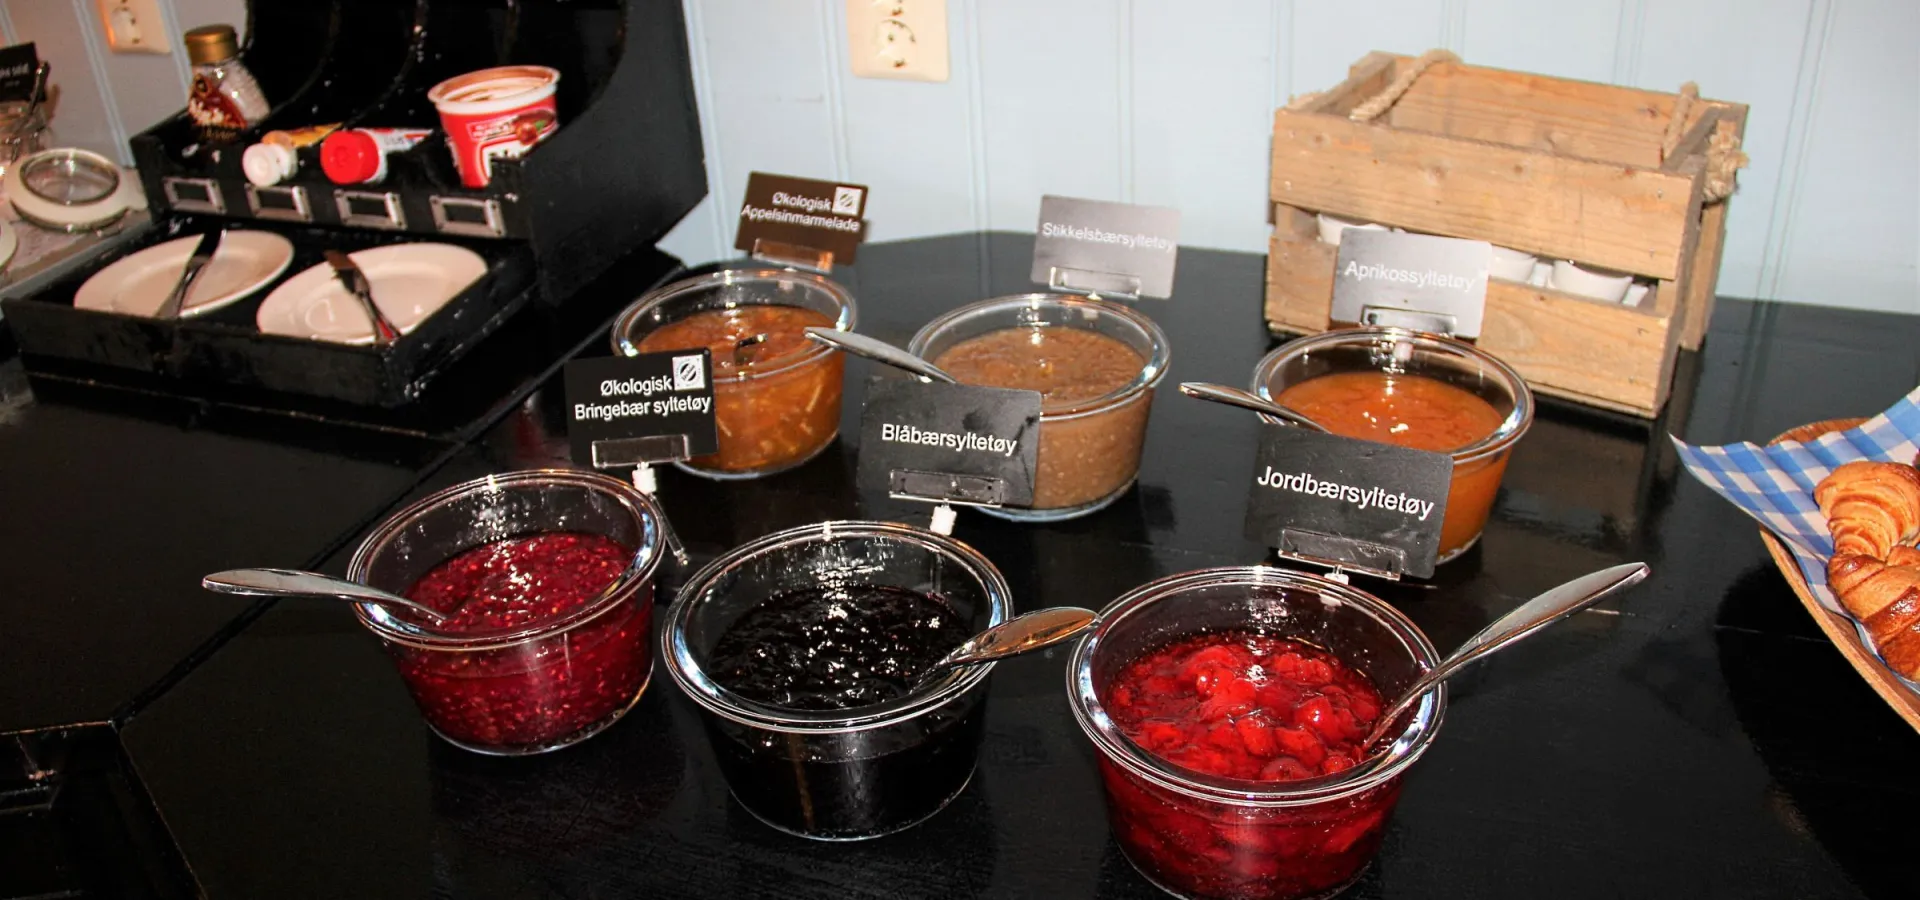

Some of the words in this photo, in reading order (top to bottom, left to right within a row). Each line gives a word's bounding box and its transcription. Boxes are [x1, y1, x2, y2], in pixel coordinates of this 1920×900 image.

[772, 191, 832, 213] Økologisk
[741, 204, 860, 233] Appelsinmarmelade
[1042, 221, 1177, 253] Stikkelsbærsyltetøy
[1344, 260, 1475, 292] Aprikossyltetøy
[600, 375, 674, 397] Økologisk
[574, 400, 651, 422] Bringebær
[653, 395, 712, 417] syltetøy
[881, 423, 1018, 457] Blåbærsyltetøy
[1257, 465, 1435, 521] Jordbærsyltetøy
